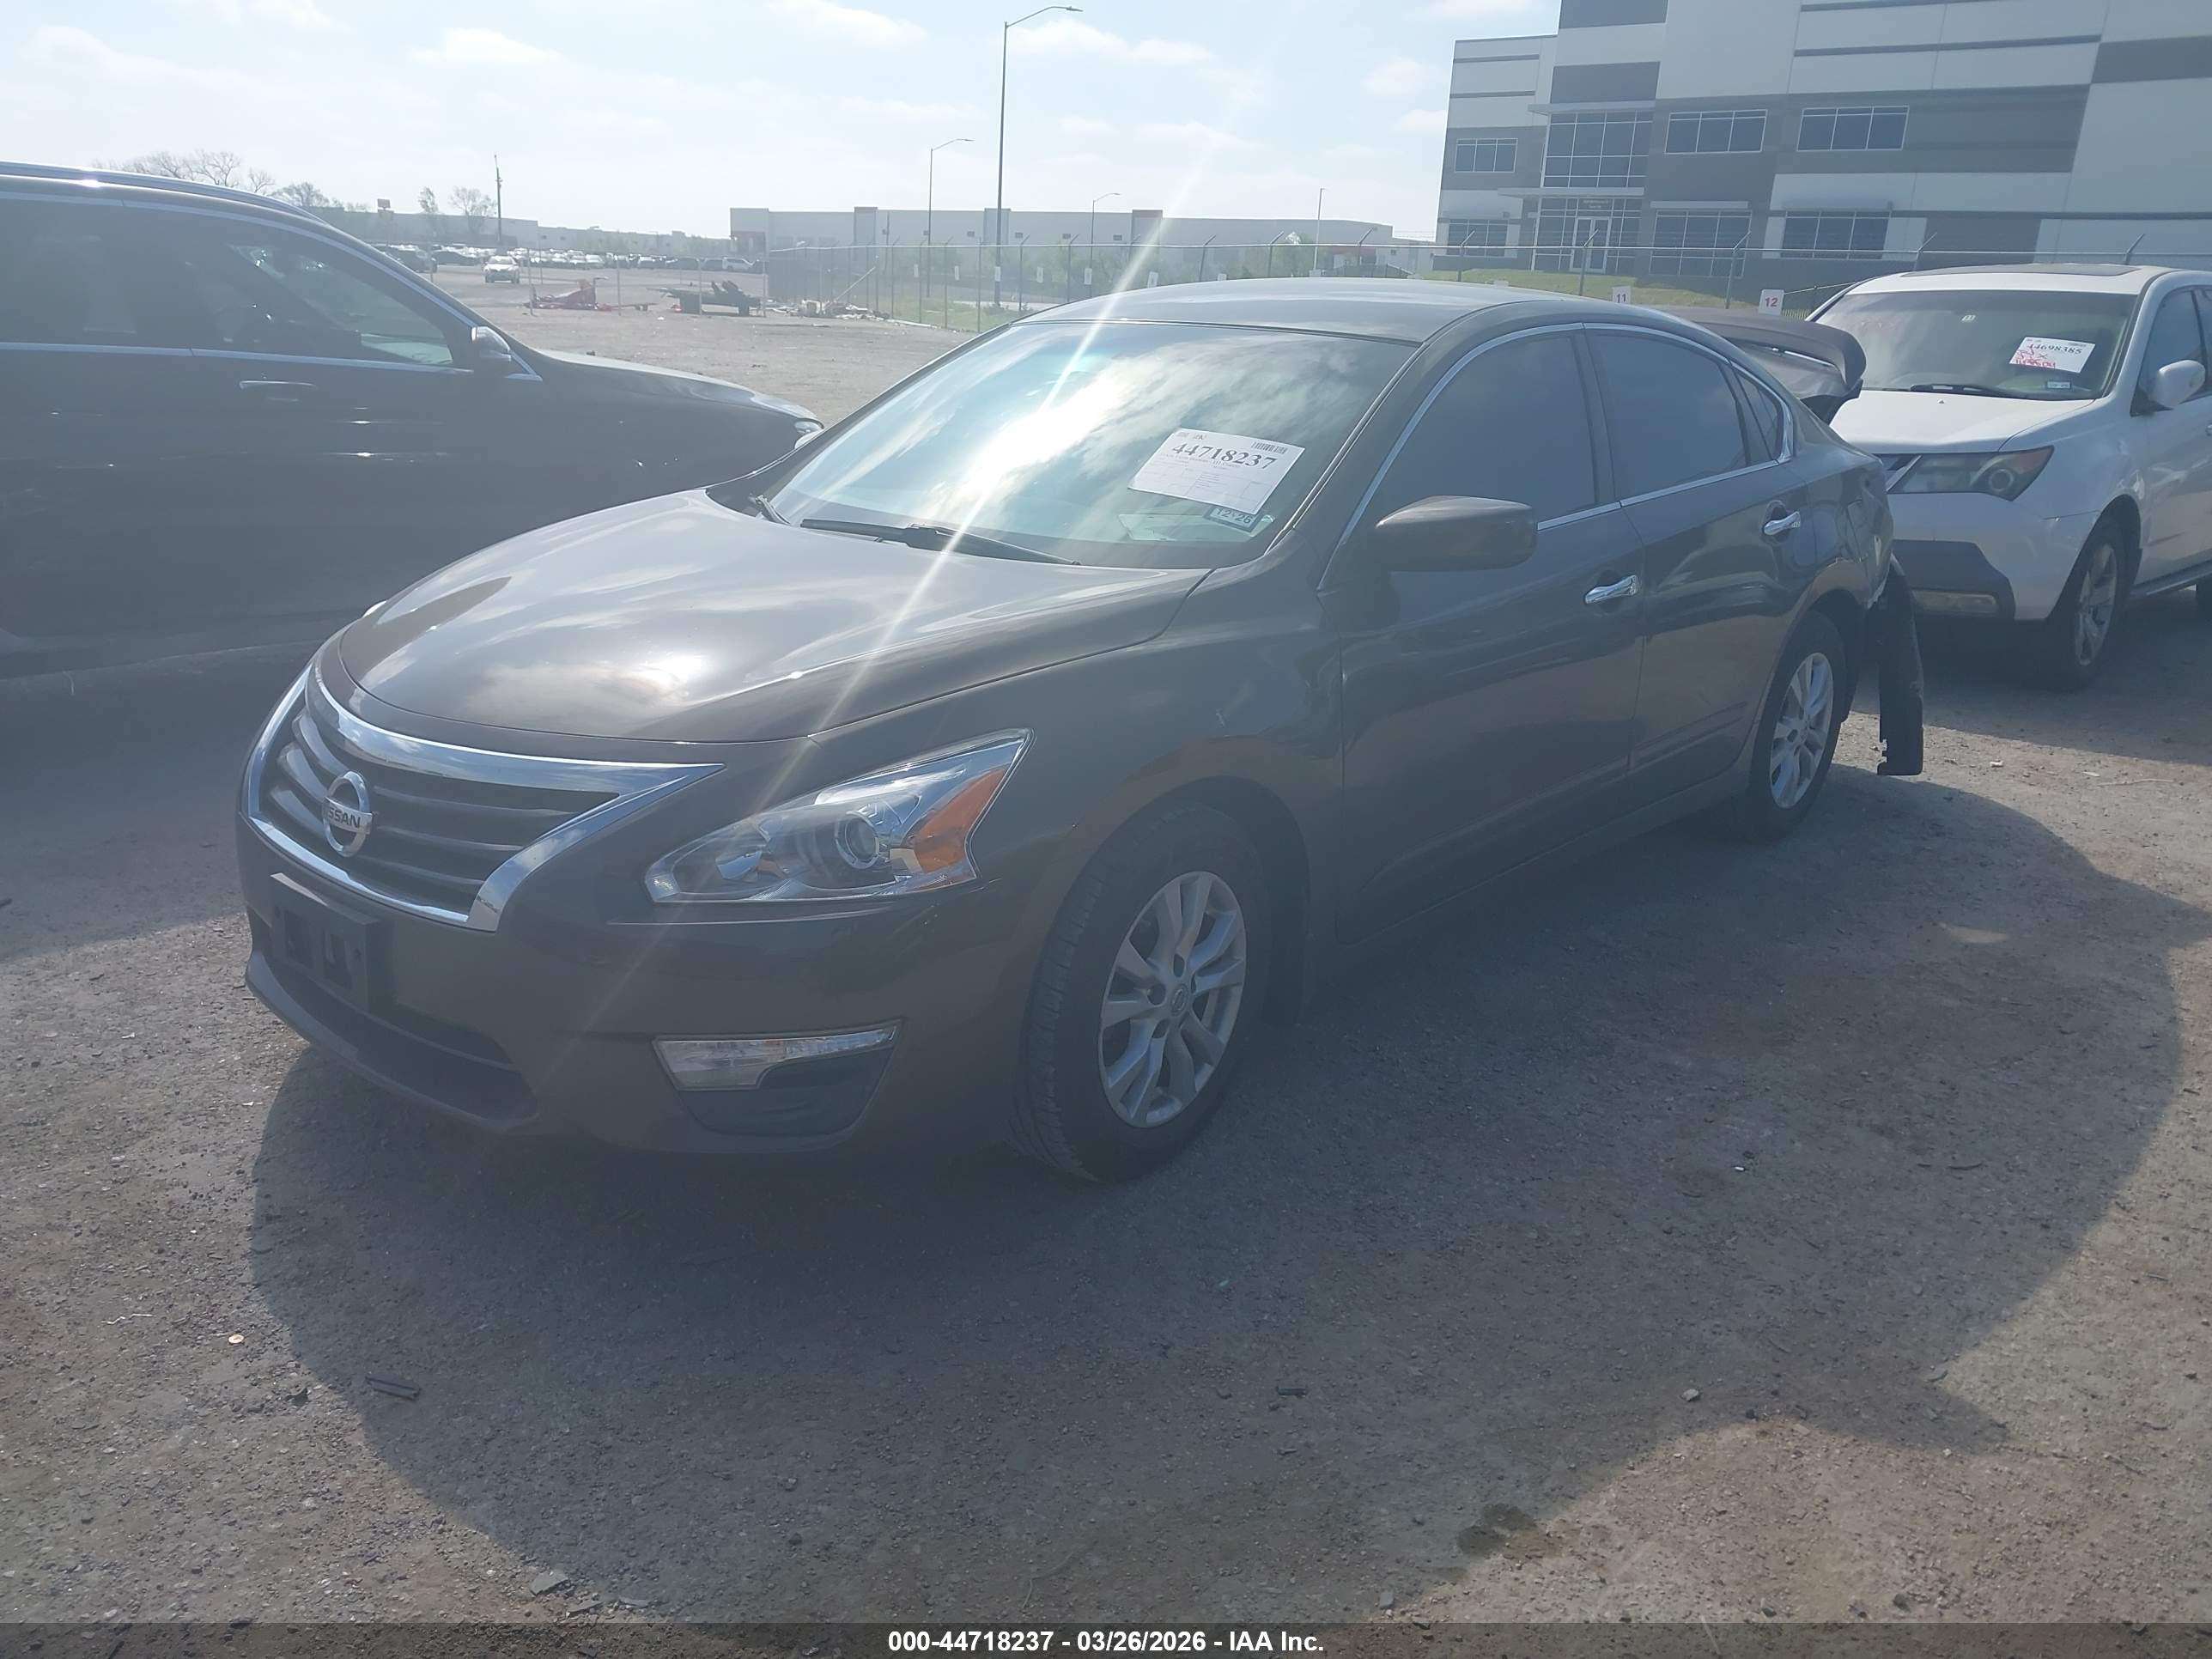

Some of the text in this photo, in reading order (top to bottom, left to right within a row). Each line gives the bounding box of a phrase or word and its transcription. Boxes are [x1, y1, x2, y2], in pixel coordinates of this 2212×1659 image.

[1616, 293, 1626, 303] 11
[1765, 297, 1778, 307] 12
[1172, 442, 1278, 470] 44718237
[1235, 514, 1253, 524] 26
[326, 805, 362, 829] SSAN
